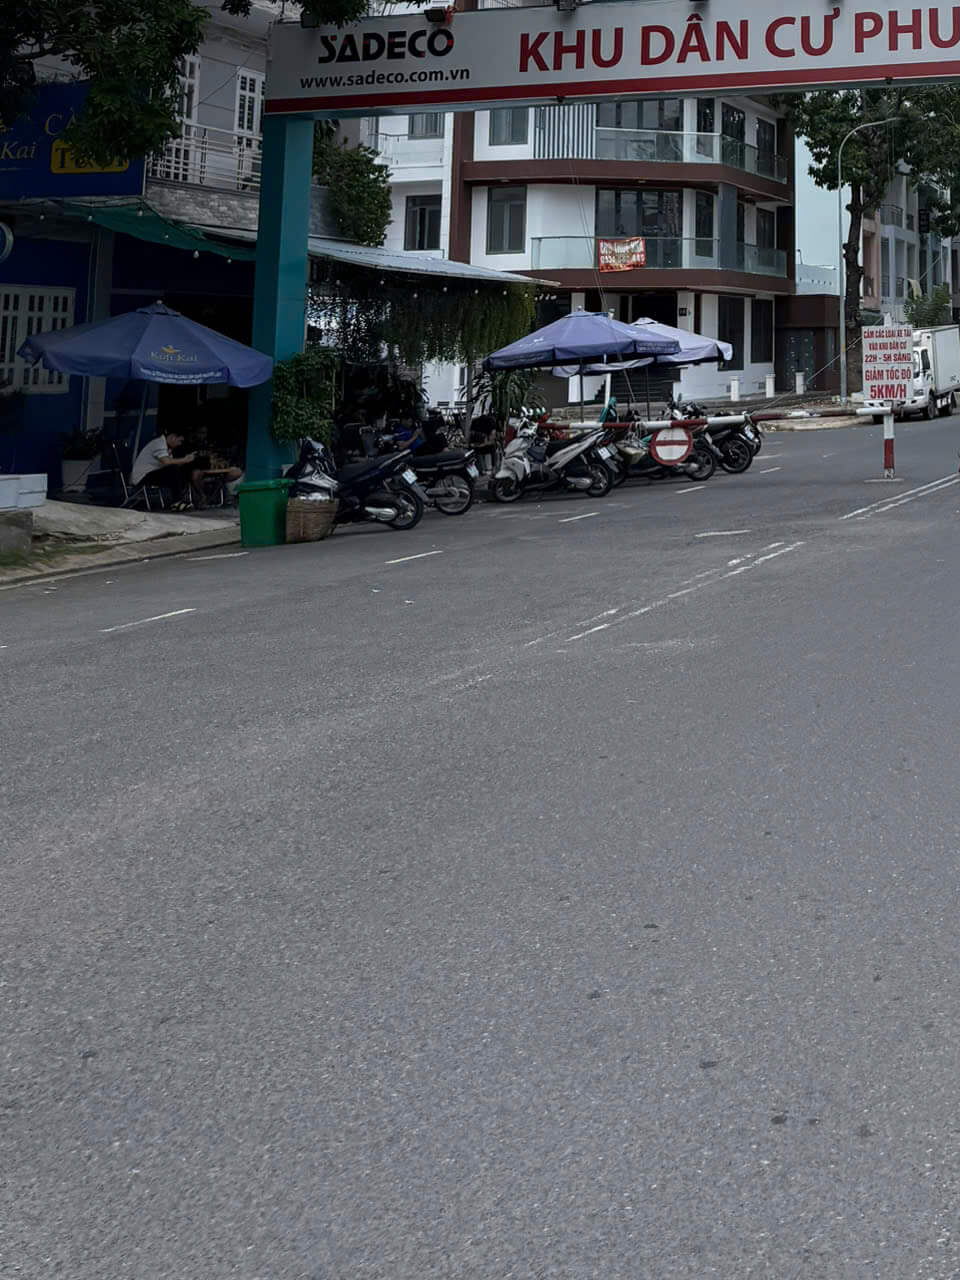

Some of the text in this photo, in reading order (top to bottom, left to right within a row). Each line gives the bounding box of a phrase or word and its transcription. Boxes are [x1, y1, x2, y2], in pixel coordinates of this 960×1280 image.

[318, 28, 455, 65] SADECO
[519, 27, 624, 73] KHU
[640, 13, 750, 66] DÂN
[765, 7, 841, 58] CƯ
[300, 68, 470, 89] www.sadeco.com.vn
[865, 354, 877, 362] 22H
[883, 353, 892, 361] 5H
[893, 351, 911, 362] SÁNG
[865, 366, 911, 382] GIẢM TỐC ĐỘ
[870, 384, 907, 400] 5KM/H
